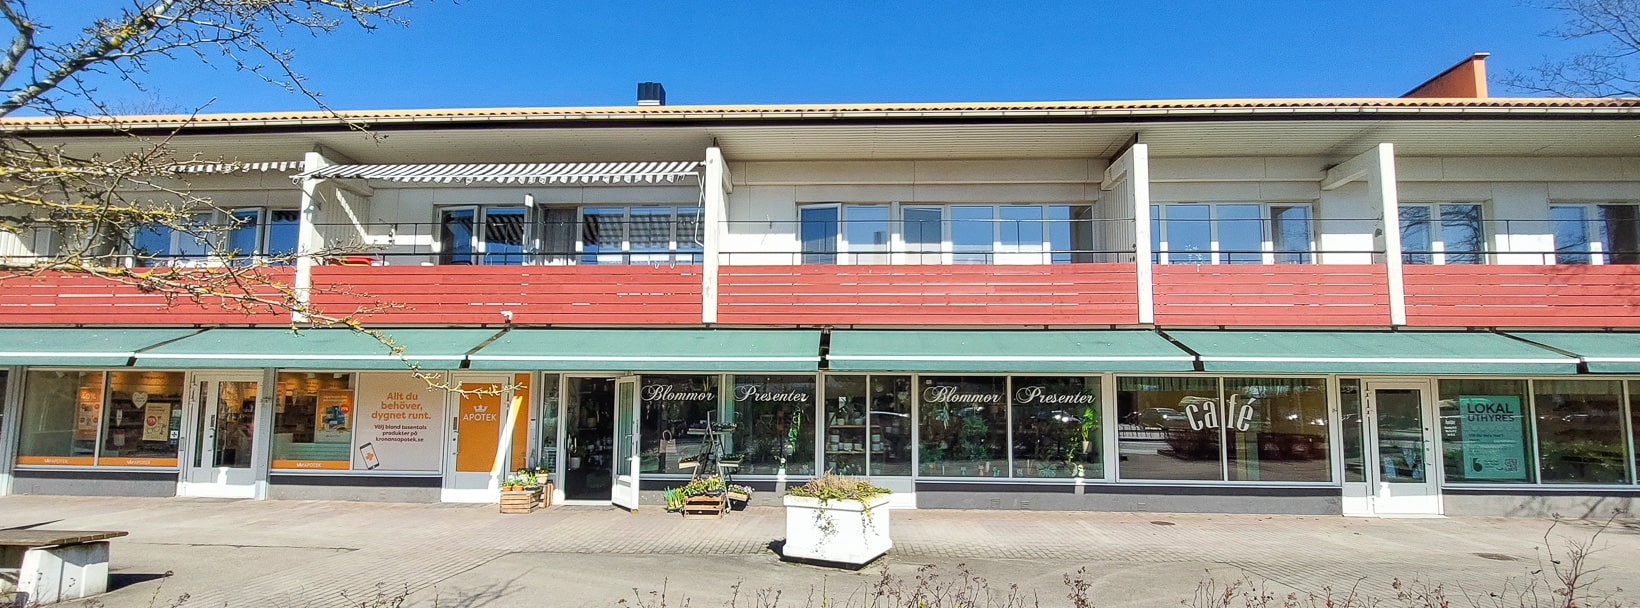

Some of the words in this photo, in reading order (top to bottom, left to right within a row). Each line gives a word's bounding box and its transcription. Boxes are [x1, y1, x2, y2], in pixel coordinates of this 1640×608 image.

[386, 392, 404, 401] Allt
[406, 392, 418, 401] du
[641, 384, 715, 402] Blommor
[734, 384, 809, 403] Presenter
[923, 385, 1002, 403] Blommor
[1015, 385, 1096, 404] Presenter
[381, 401, 423, 411] behöver,
[1467, 403, 1514, 414] LOKAL
[371, 411, 407, 421] dygnet
[408, 412, 432, 420] runt.
[462, 413, 497, 422] APOTEK
[1185, 393, 1256, 432] café
[1468, 414, 1515, 422] UTHYRES
